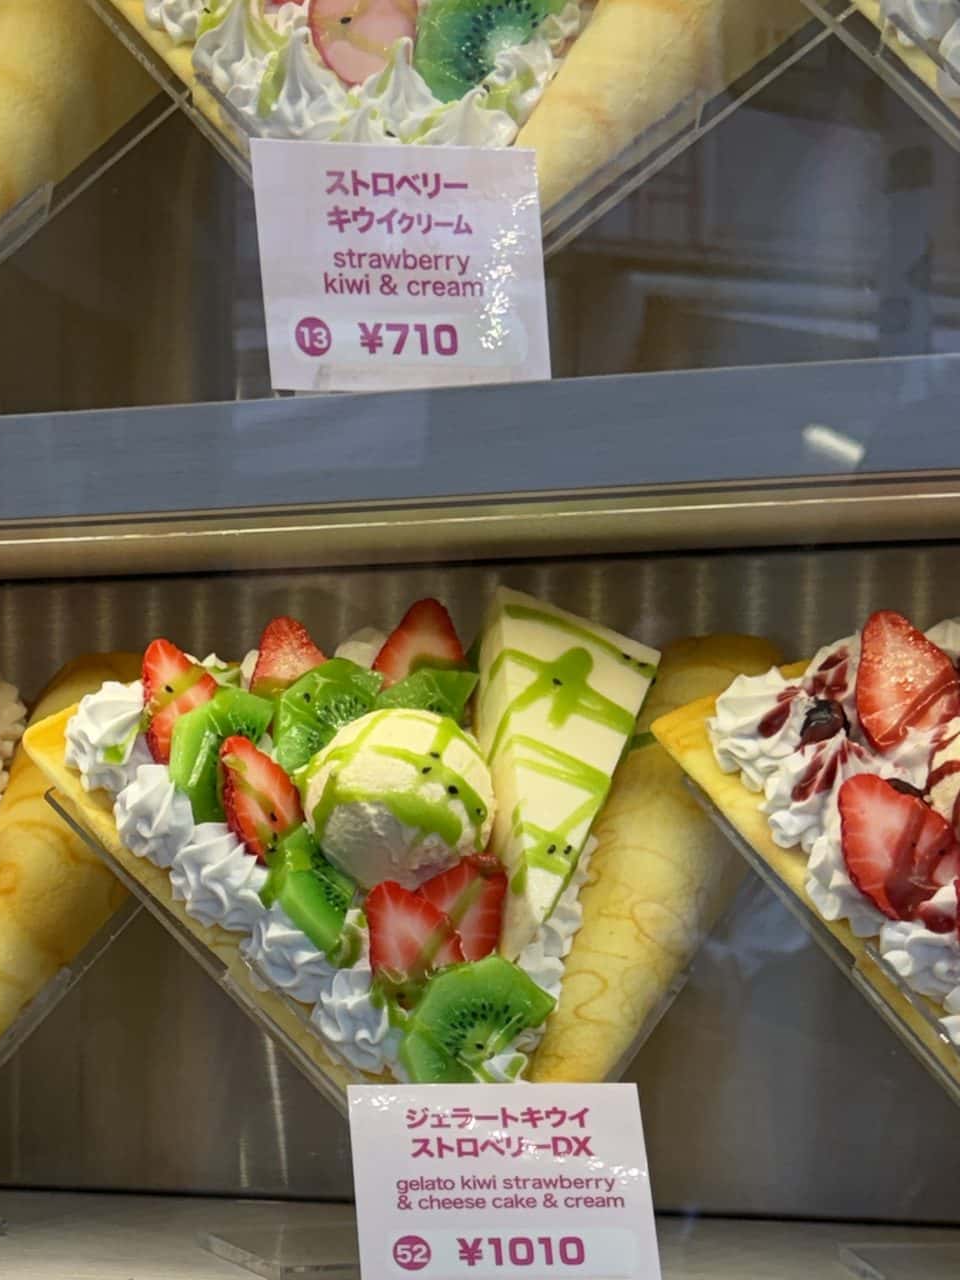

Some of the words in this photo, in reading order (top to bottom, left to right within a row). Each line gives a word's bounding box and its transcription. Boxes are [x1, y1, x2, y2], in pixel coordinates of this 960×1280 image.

[325, 170, 468, 198] ストロベリー
[328, 206, 472, 234] キウイクリーム
[333, 249, 470, 275] strawberry
[324, 273, 370, 294] kiwi
[380, 276, 398, 296] &
[407, 280, 484, 296] cream
[300, 326, 328, 348] 13
[358, 322, 459, 356] ¥710
[406, 1107, 590, 1129] ジェラートキウイ
[410, 1136, 595, 1159] ストロベリーDX
[396, 1176, 455, 1194] gelato
[461, 1175, 497, 1190] kiwi
[503, 1175, 615, 1191] strawberry
[397, 1196, 412, 1210] &
[418, 1194, 486, 1209] cheese
[492, 1193, 537, 1208] cake
[544, 1193, 558, 1208] &
[564, 1193, 625, 1208] cream
[396, 1245, 429, 1263] 52
[457, 1236, 585, 1266] ¥1010
